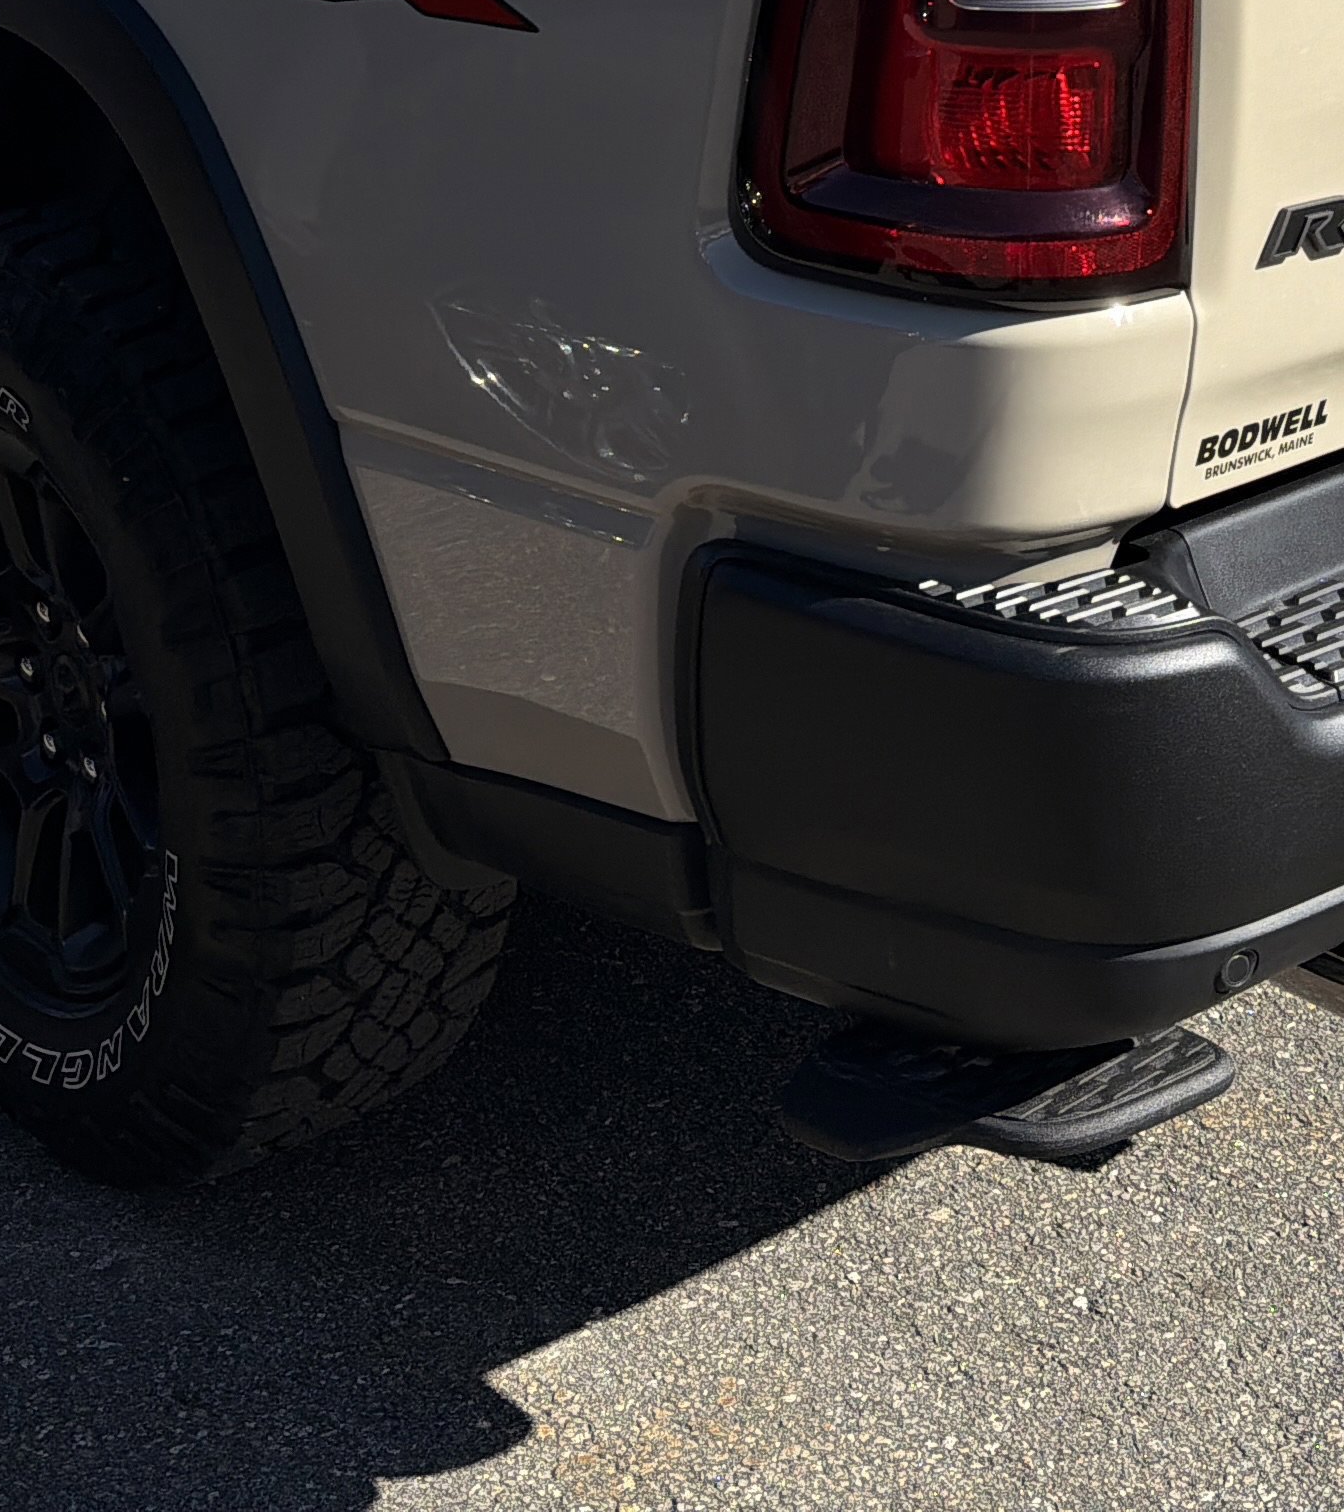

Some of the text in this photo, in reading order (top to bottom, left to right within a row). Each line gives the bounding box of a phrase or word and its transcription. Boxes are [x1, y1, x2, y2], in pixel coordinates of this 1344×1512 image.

[1195, 399, 1329, 467] BODWELL
[1205, 433, 1314, 480] BRUNSWICK, MAINE
